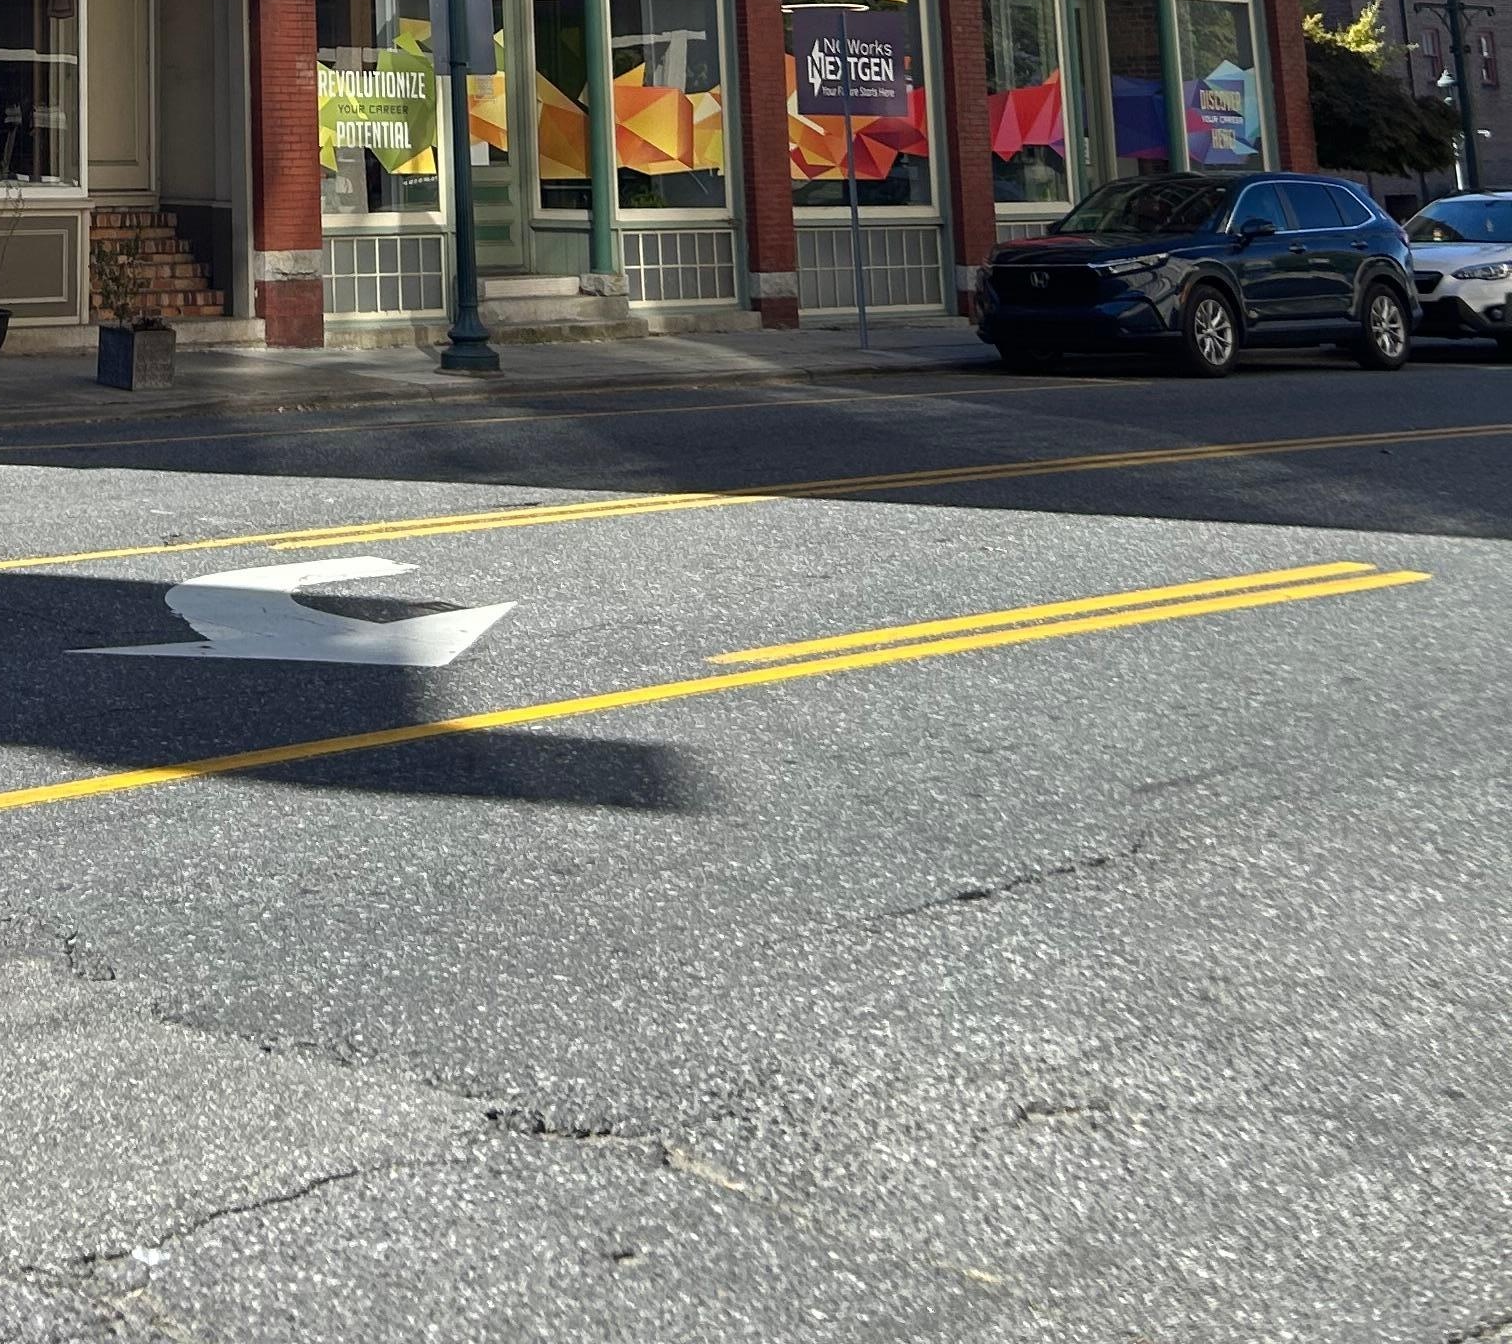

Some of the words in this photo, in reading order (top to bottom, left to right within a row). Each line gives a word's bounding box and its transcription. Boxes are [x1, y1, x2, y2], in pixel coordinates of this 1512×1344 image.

[846, 39, 893, 56] Works
[317, 70, 426, 99] REVOLUTIONIZE
[338, 104, 365, 114] YOUR
[368, 104, 408, 115] CAREER
[336, 121, 412, 149] POTENTIAL
